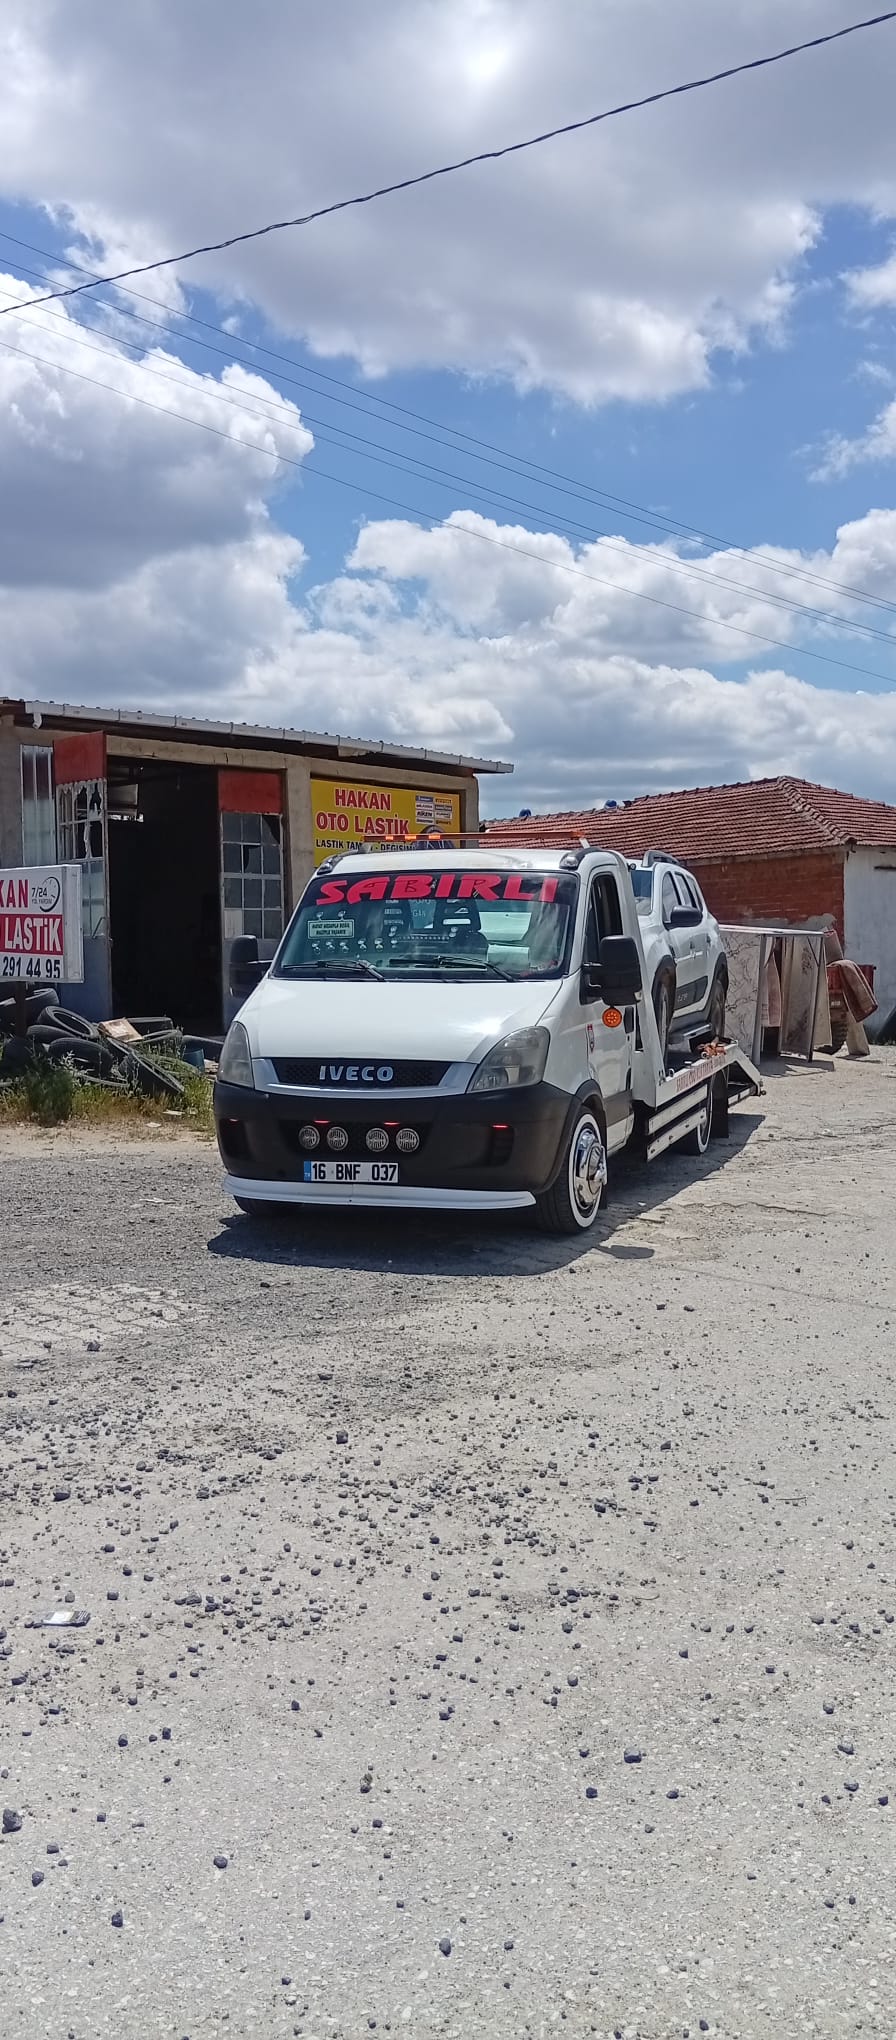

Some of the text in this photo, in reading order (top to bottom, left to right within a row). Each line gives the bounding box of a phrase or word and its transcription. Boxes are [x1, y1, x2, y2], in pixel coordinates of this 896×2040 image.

[335, 788, 391, 811] HAKAN
[316, 812, 349, 831] OTO
[32, 886, 47, 897] 7/24
[316, 873, 558, 905] SABIRLI
[3, 956, 60, 978] 291 44 95
[319, 1065, 394, 1081] IVECO
[312, 1163, 397, 1181] 16 BNF 037
